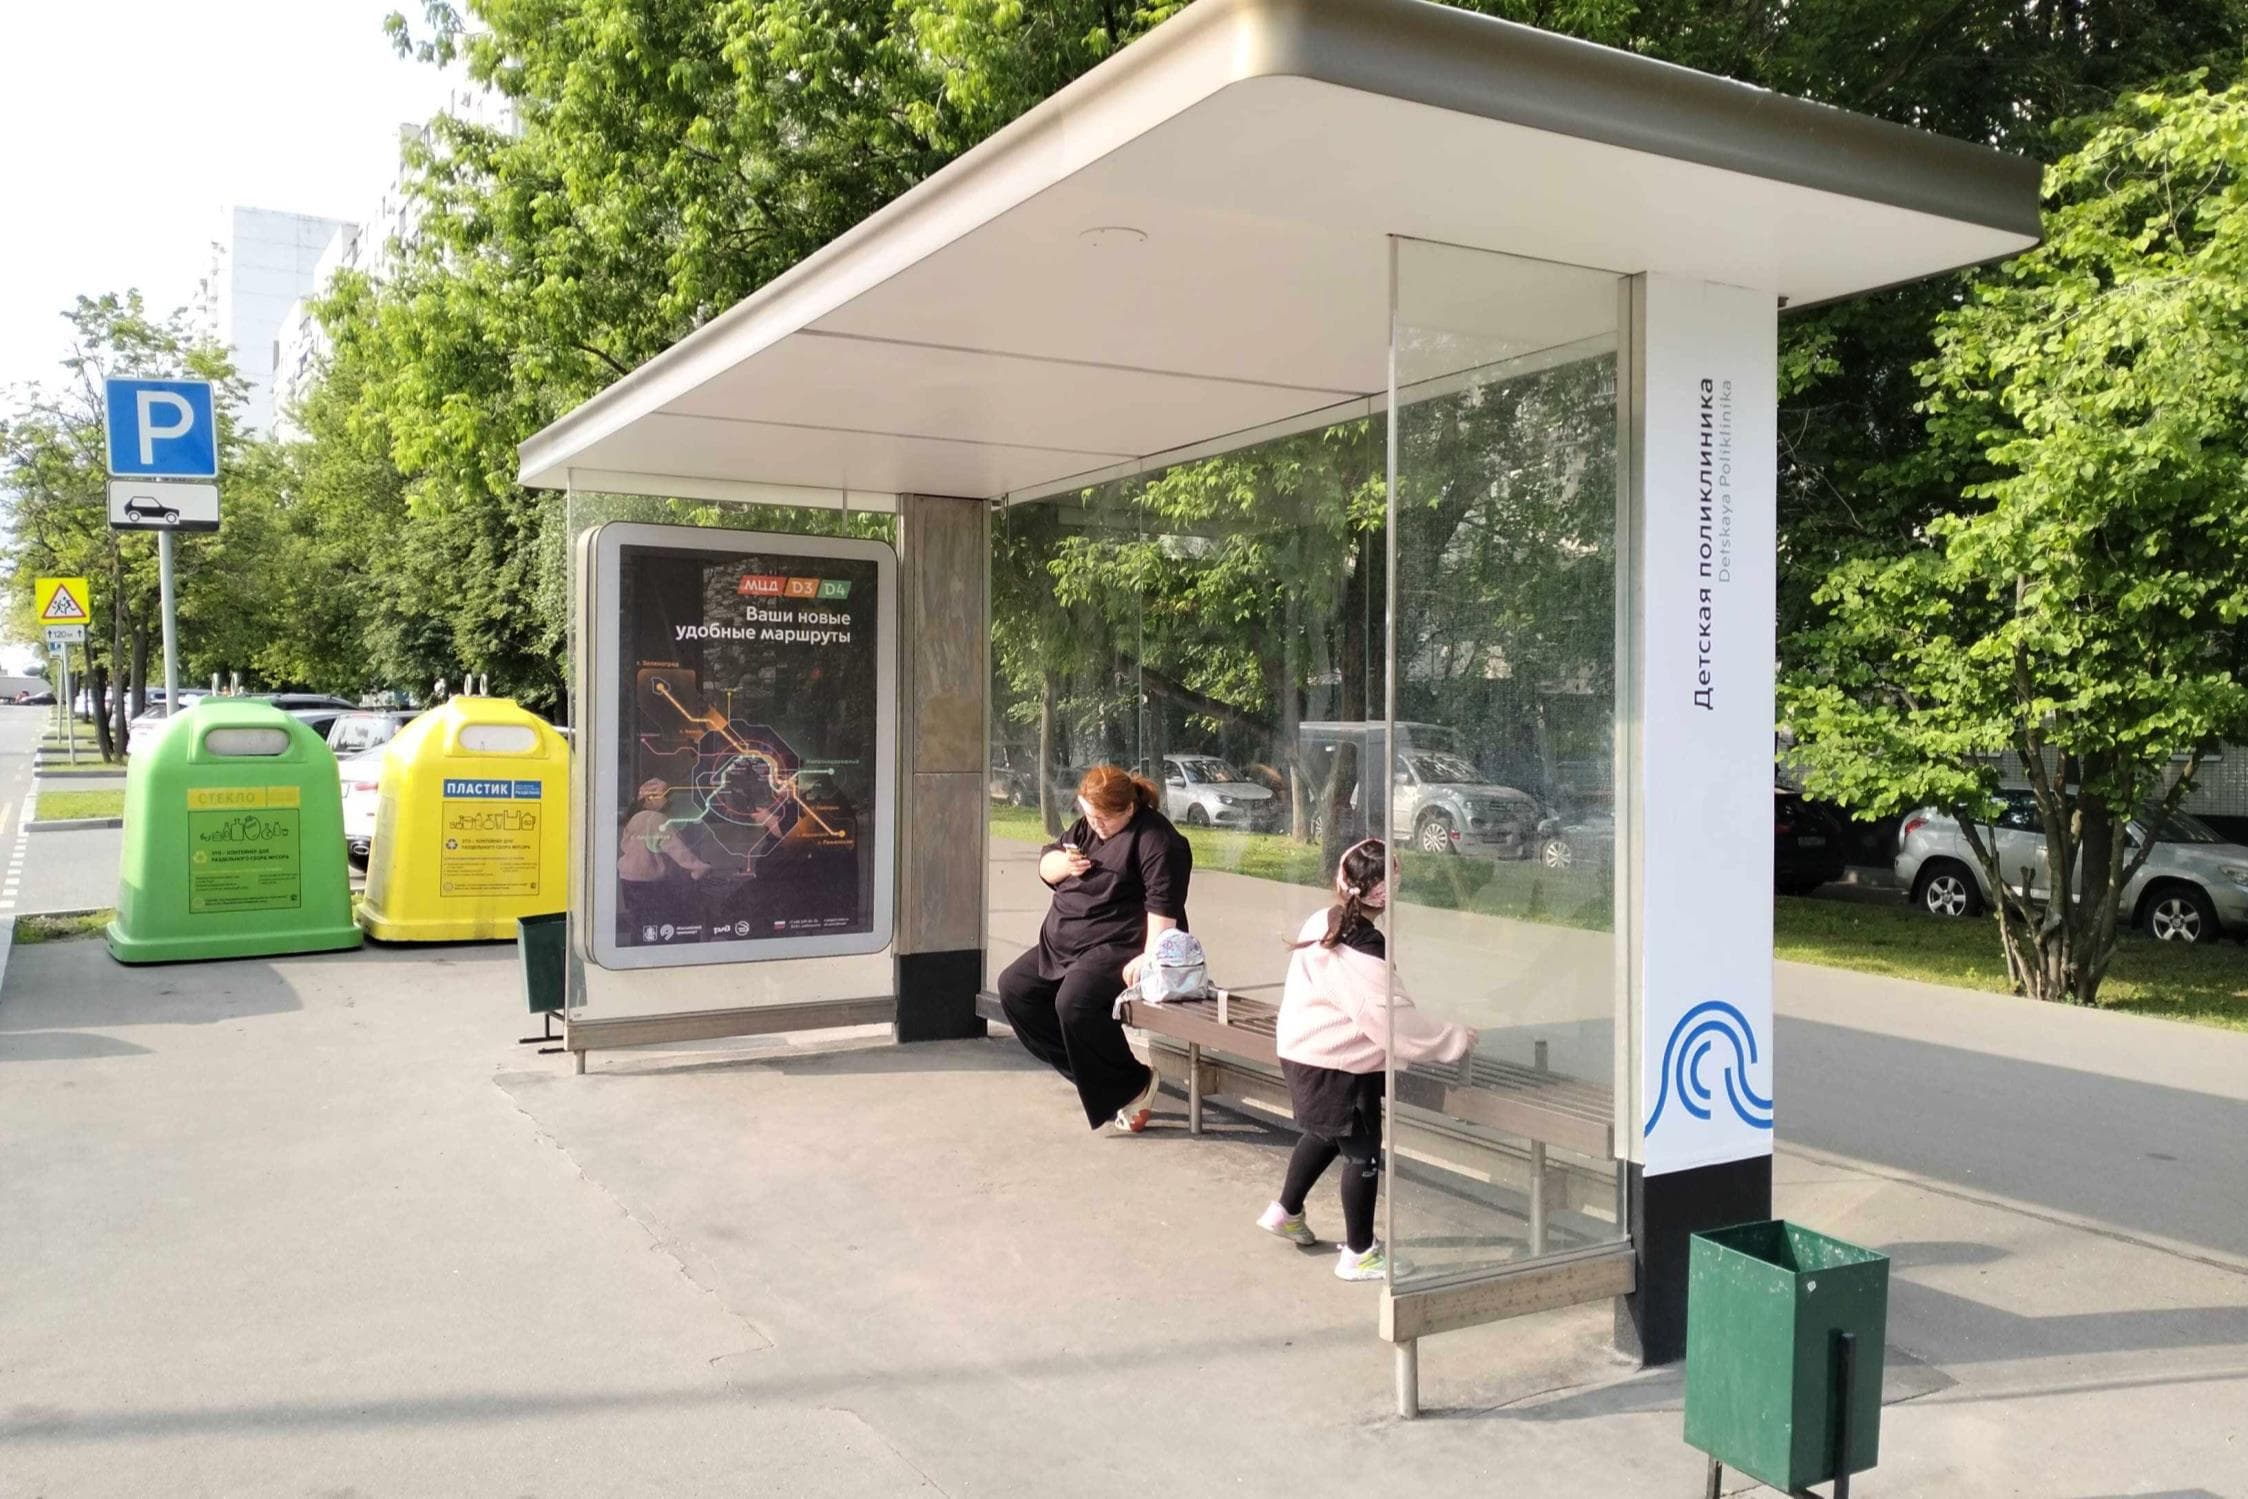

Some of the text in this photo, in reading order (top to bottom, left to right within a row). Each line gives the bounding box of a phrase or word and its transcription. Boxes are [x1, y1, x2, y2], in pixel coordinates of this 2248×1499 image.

[136, 390, 195, 465] P
[1719, 380, 1733, 583] Detskaya Poliklinika
[1694, 378, 1713, 711] Детская поликлиника
[744, 579, 845, 596] МЦД D3 D4
[746, 606, 850, 625] Ваши новые
[676, 623, 850, 646] удобные маршруты
[198, 792, 255, 804] СТЕКЛО
[447, 783, 508, 795] ПЛАСТИК
